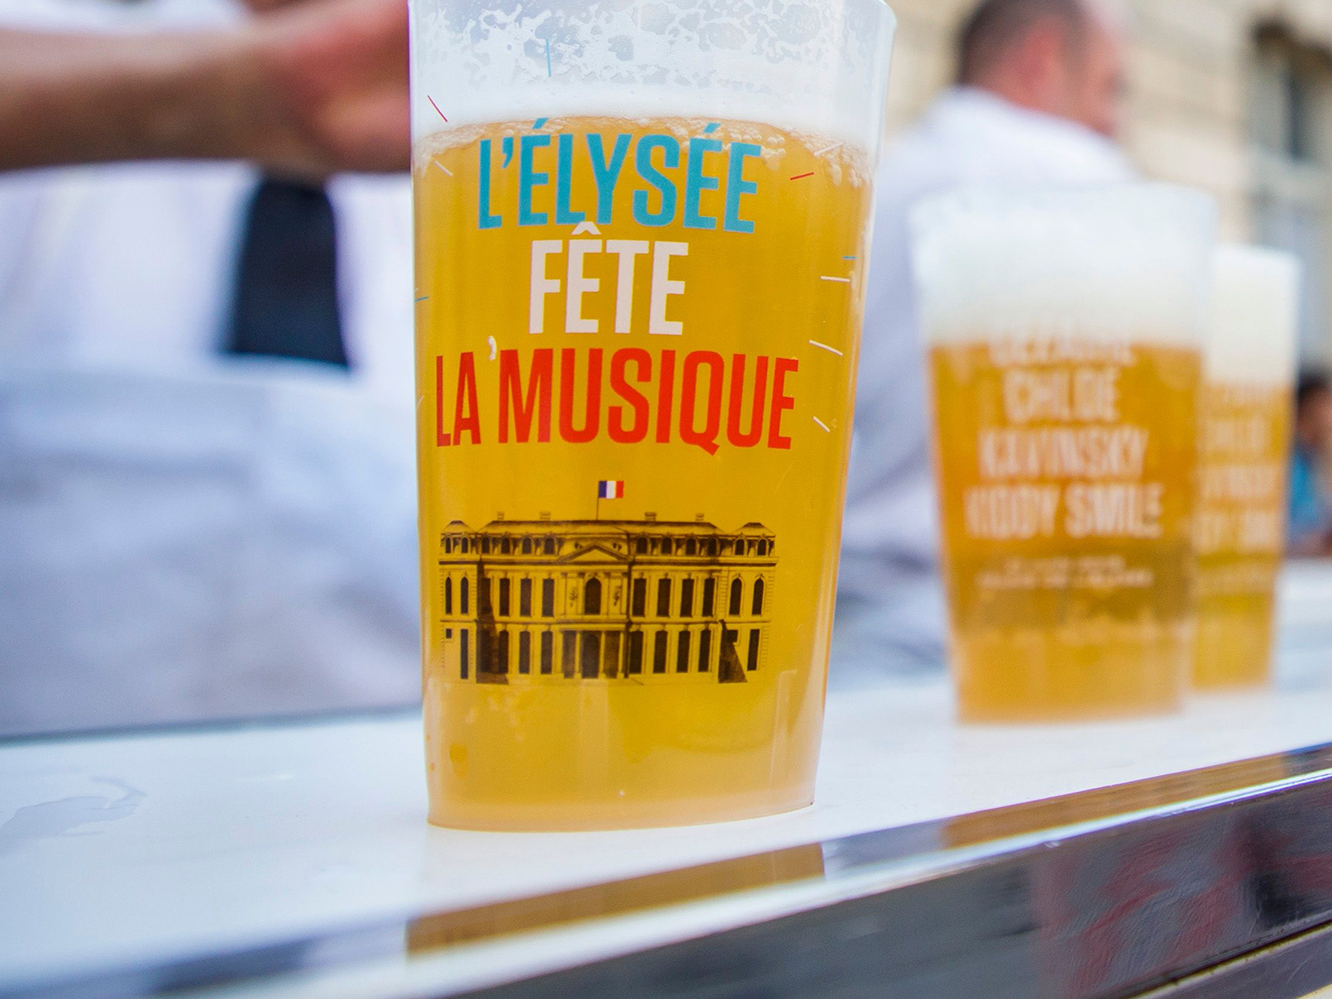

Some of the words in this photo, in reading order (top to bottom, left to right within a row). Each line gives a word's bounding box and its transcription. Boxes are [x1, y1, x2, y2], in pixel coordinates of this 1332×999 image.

[528, 221, 689, 336] FÊTE
[435, 351, 482, 449] LA
[497, 347, 799, 456] MUSIQUE
